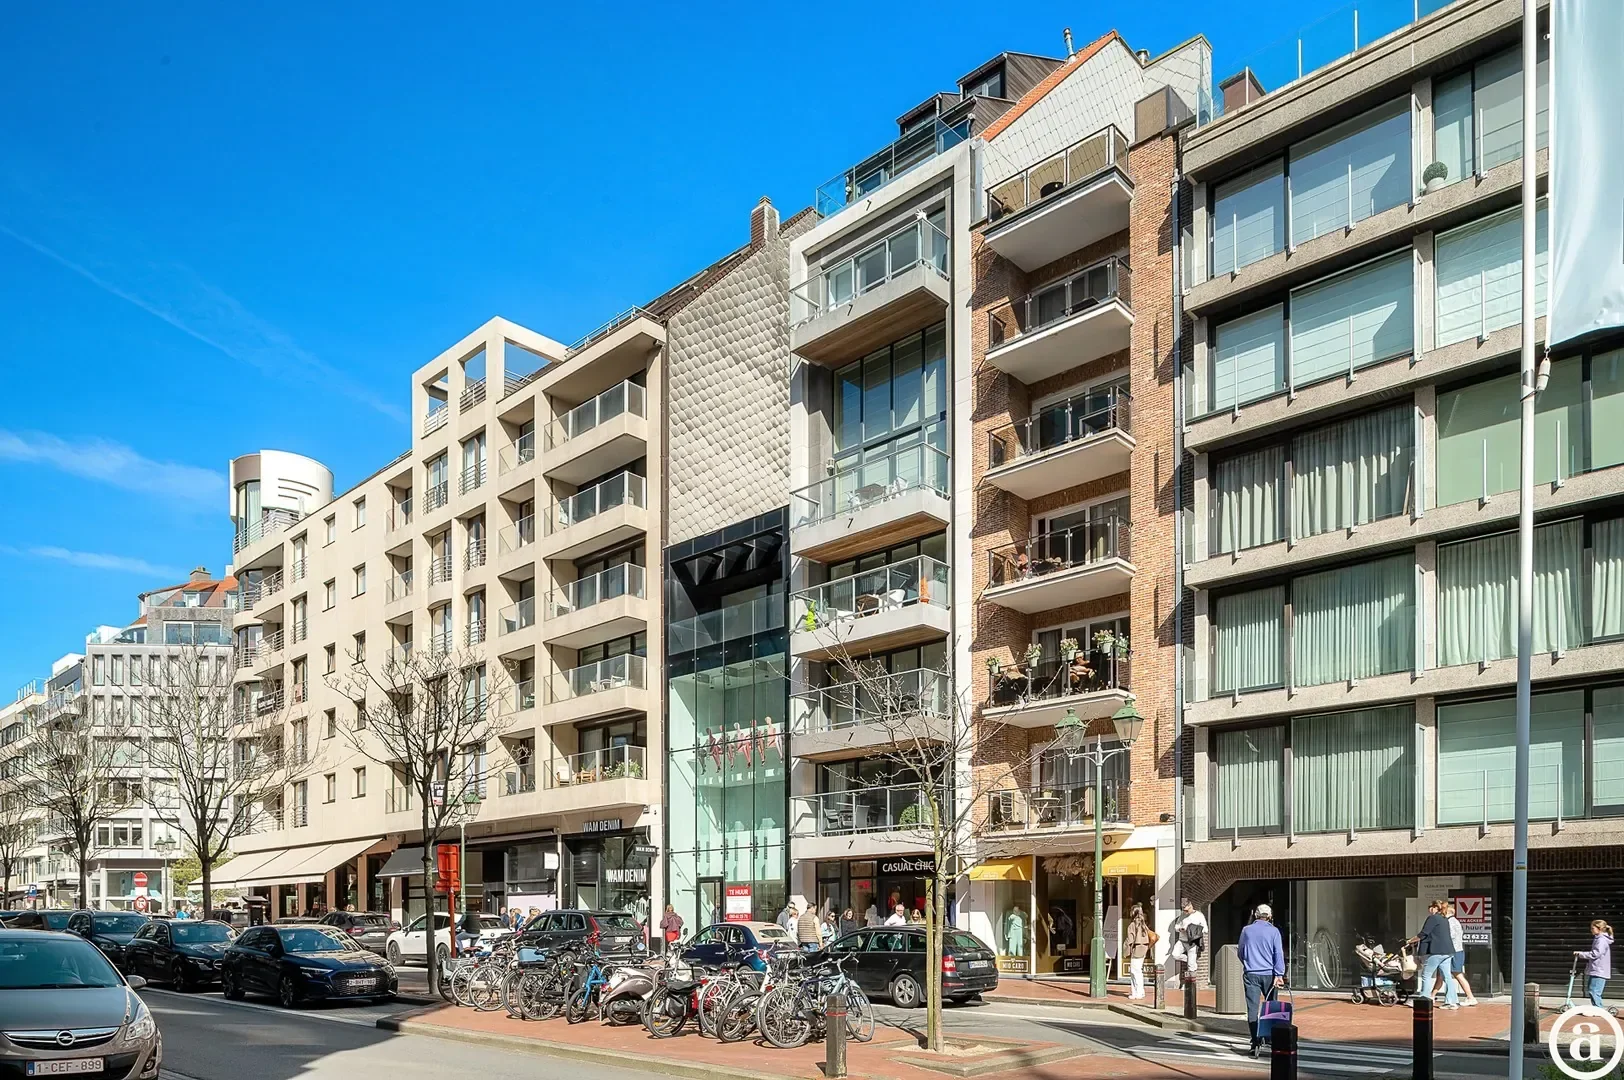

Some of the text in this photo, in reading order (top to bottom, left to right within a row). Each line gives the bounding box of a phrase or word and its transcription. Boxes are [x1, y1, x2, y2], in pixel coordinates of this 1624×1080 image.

[583, 819, 620, 832] WAM DENIM
[882, 861, 935, 872] CASUAL CHIC
[606, 869, 646, 882] WAM DENIM
[37, 1060, 102, 1073] 1-CEF-899
